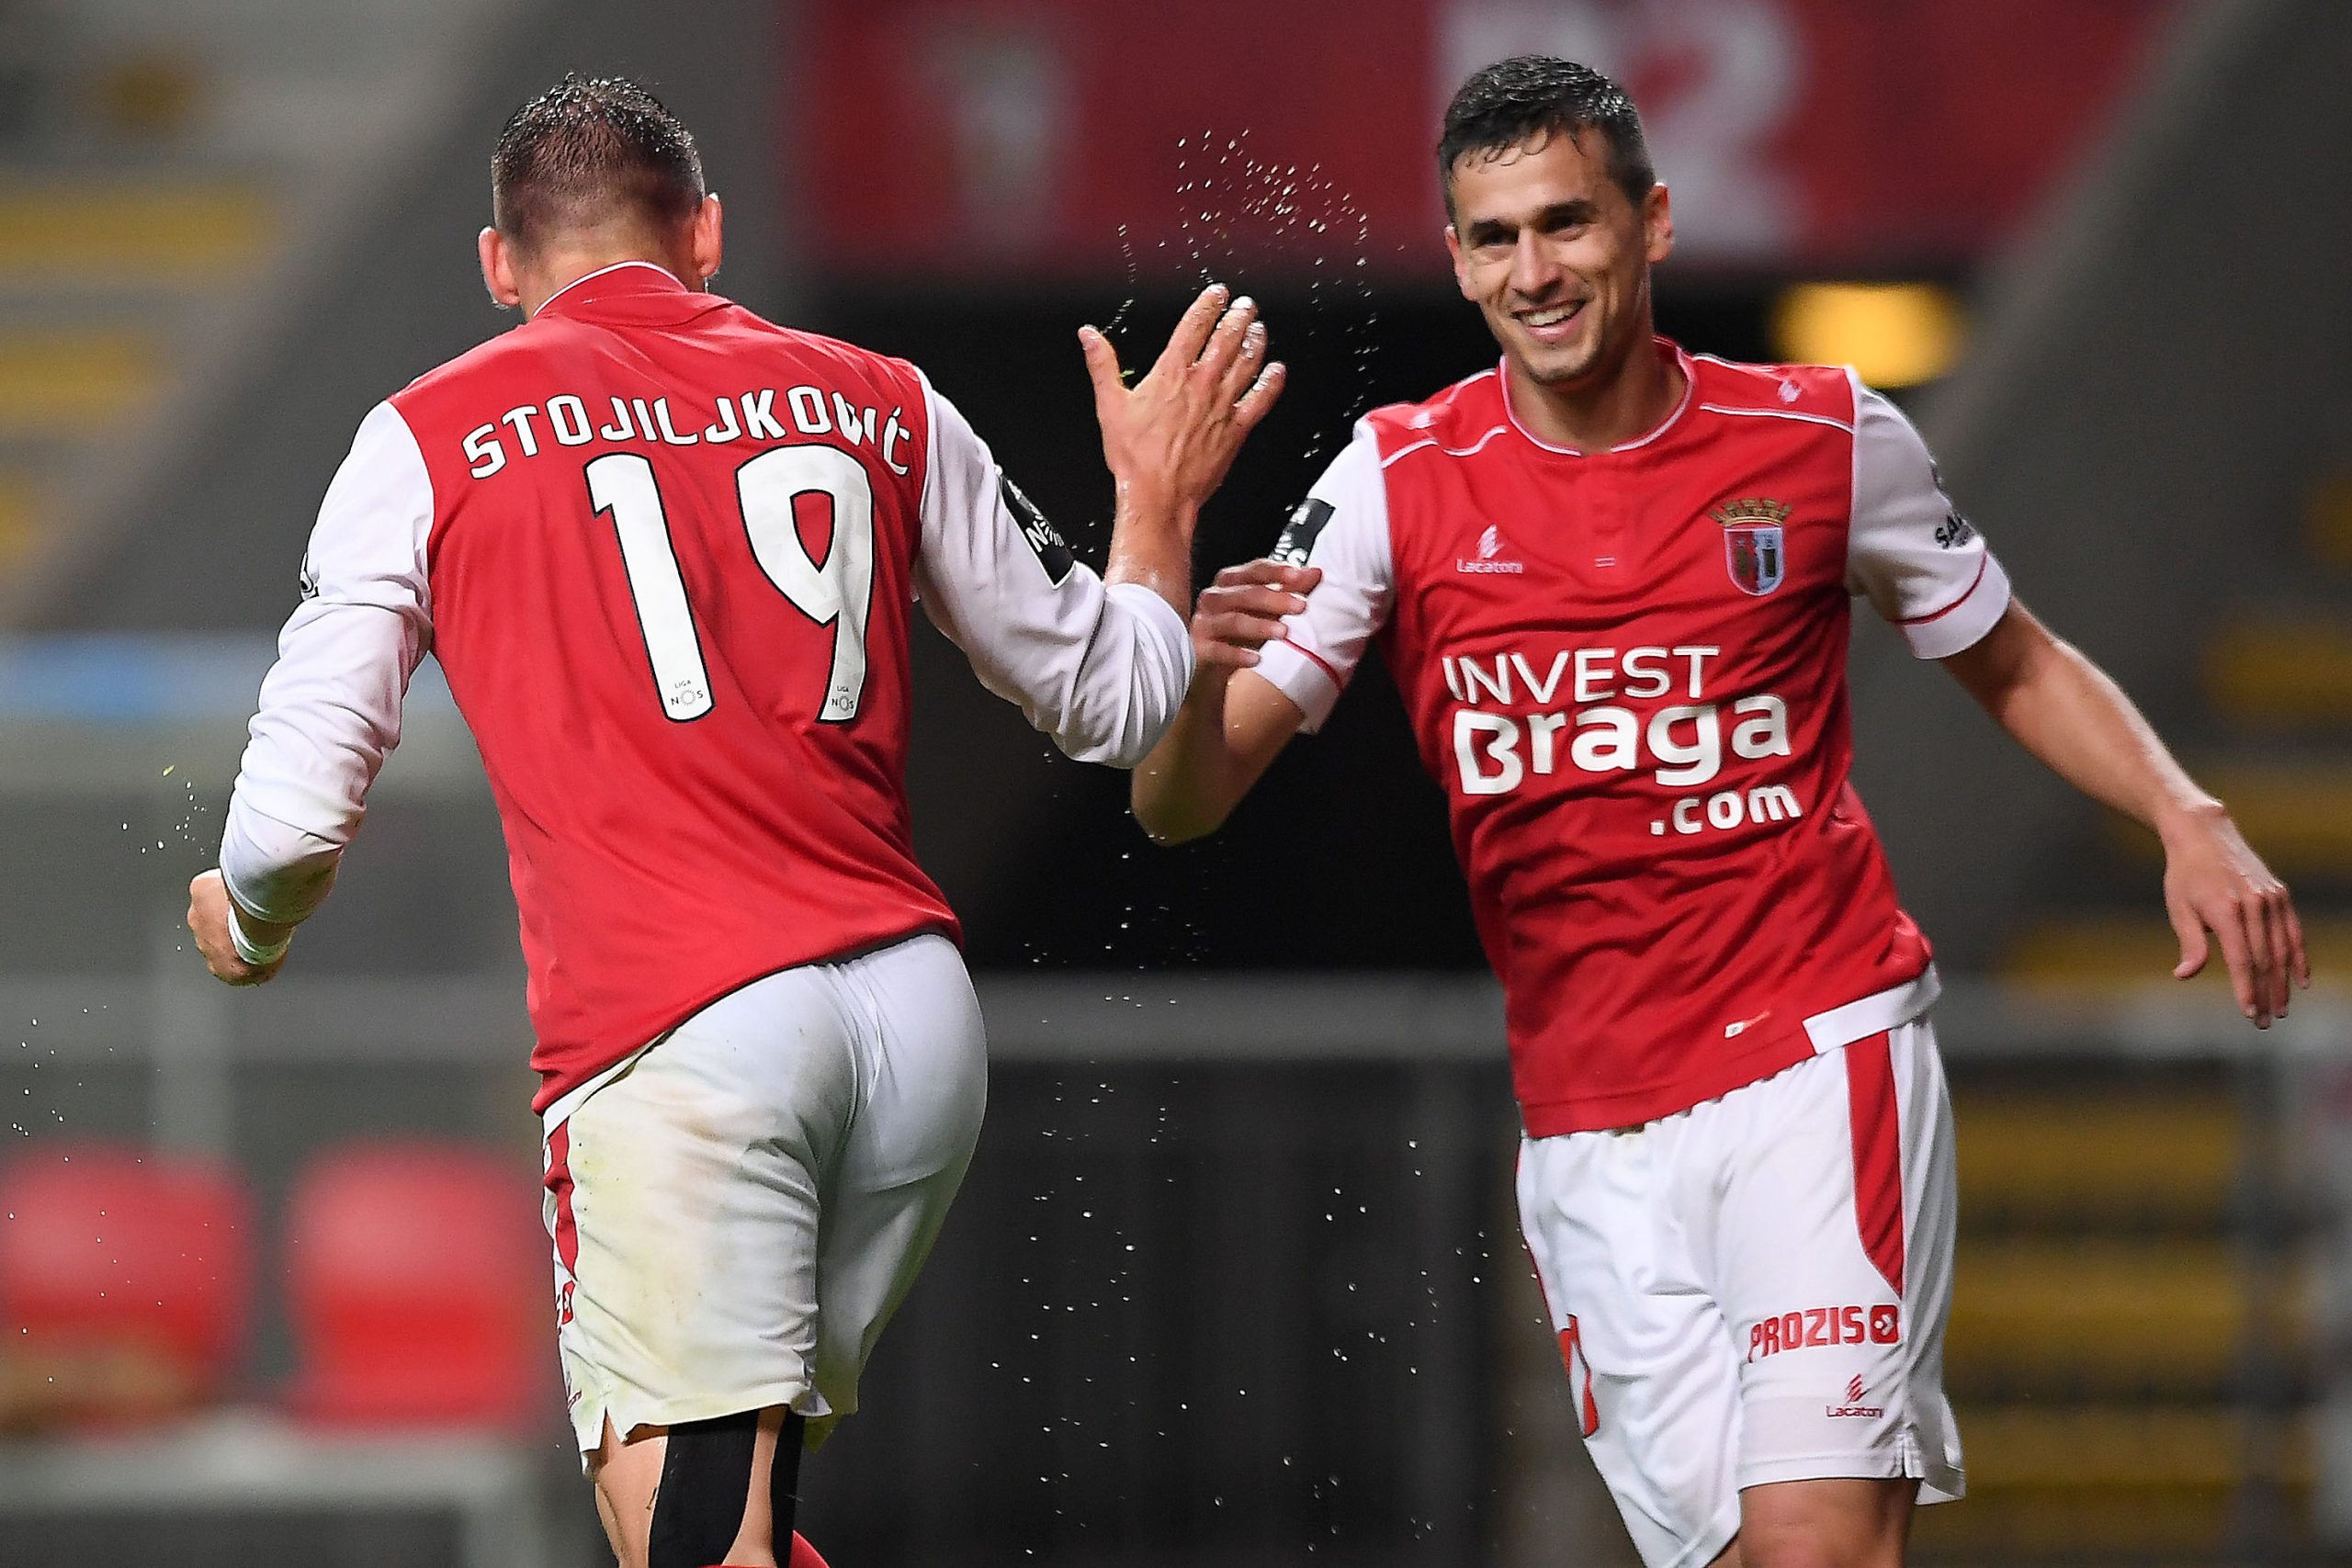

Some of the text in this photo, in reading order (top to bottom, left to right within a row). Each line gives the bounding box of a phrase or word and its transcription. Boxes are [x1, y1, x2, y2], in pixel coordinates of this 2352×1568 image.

[461, 385, 911, 479] STOJILJKOVIĆ
[583, 443, 874, 724] 19
[674, 680, 692, 689] LIGA
[836, 685, 850, 694] LIGA
[1442, 645, 1721, 705] INVEST
[1453, 694, 1792, 795] Braga
[1650, 783, 1803, 836] .com
